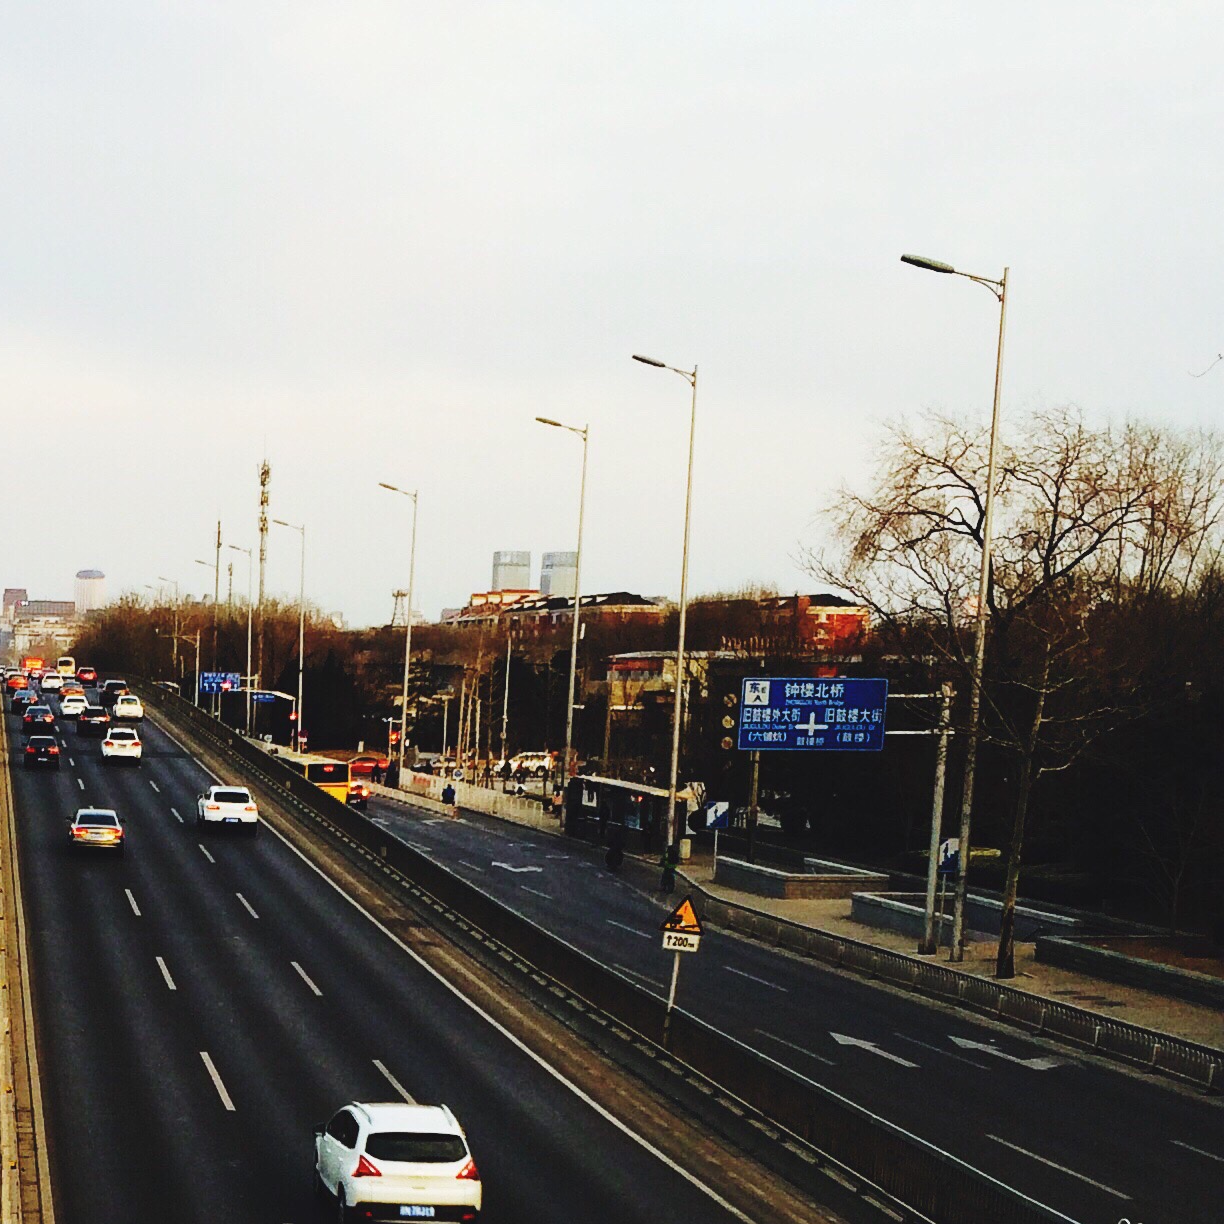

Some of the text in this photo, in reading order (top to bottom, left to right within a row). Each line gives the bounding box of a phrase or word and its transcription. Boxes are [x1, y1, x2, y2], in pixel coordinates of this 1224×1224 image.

[784, 682, 845, 698] 钟楼北桥
[743, 707, 801, 722] 旧鼓楼外大街
[824, 708, 883, 723] 旧鼓楼大街
